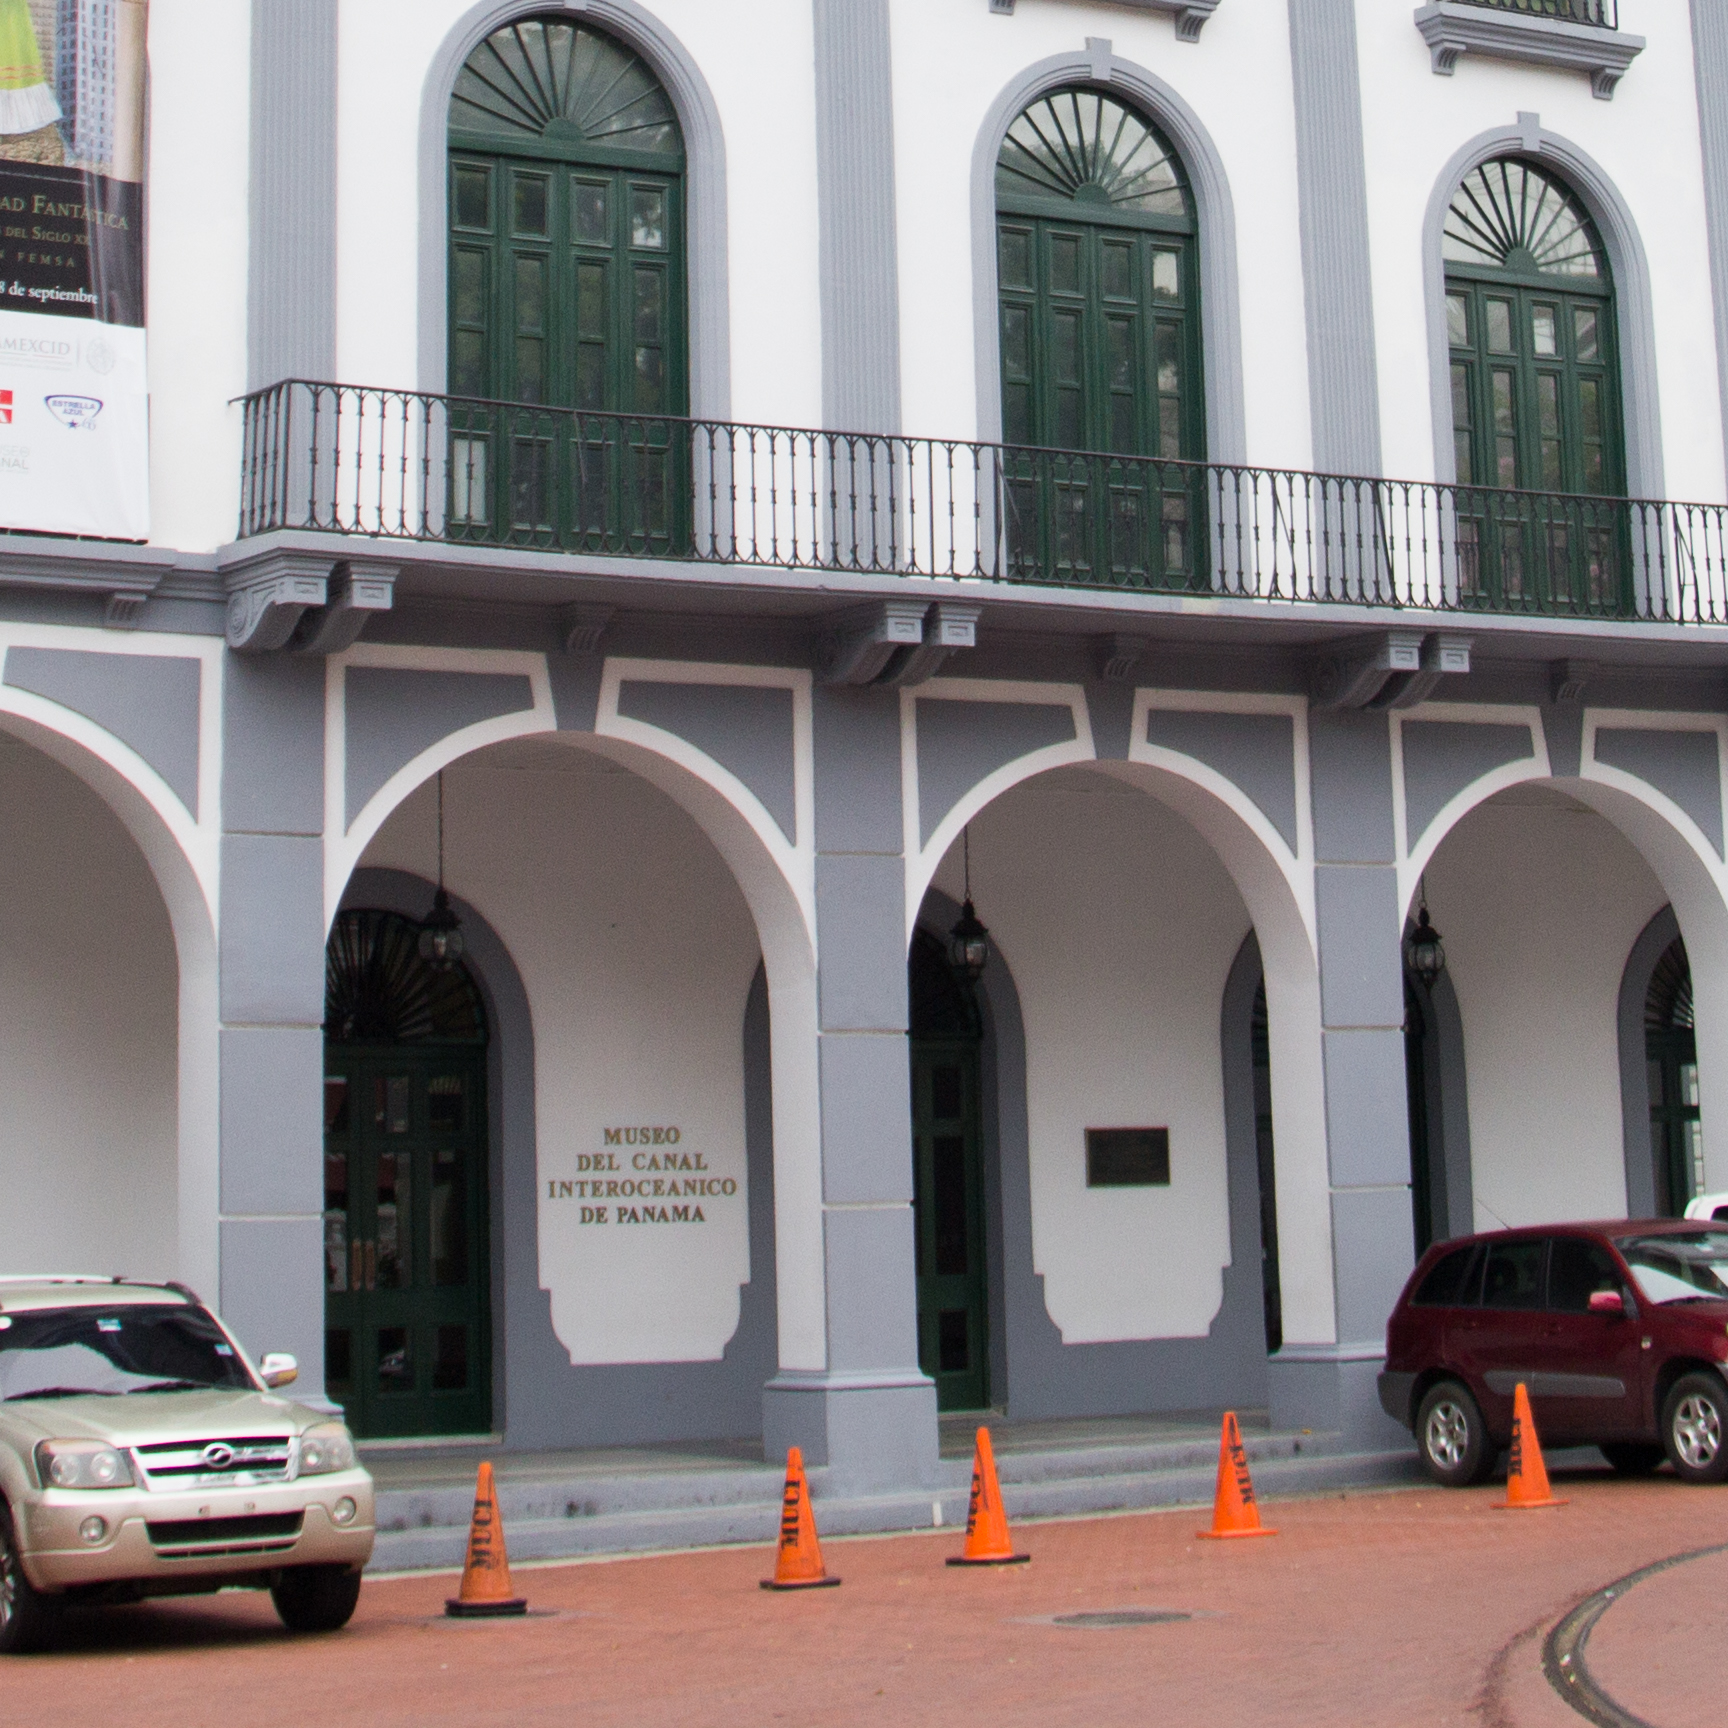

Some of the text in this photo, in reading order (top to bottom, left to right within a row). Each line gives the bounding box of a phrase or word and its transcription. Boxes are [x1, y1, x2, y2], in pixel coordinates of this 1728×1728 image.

[17, 251, 75, 268] FEMSA
[8, 280, 25, 296] de
[28, 285, 99, 304] septiembre
[604, 1126, 681, 1146] MUSEO
[576, 1152, 709, 1173] DEL CANAL
[548, 1178, 737, 1199] INTEROCEANICO
[580, 1204, 706, 1225] DE PANAMA
[781, 1479, 800, 1551] MUCI
[470, 1499, 492, 1570] MUCI
